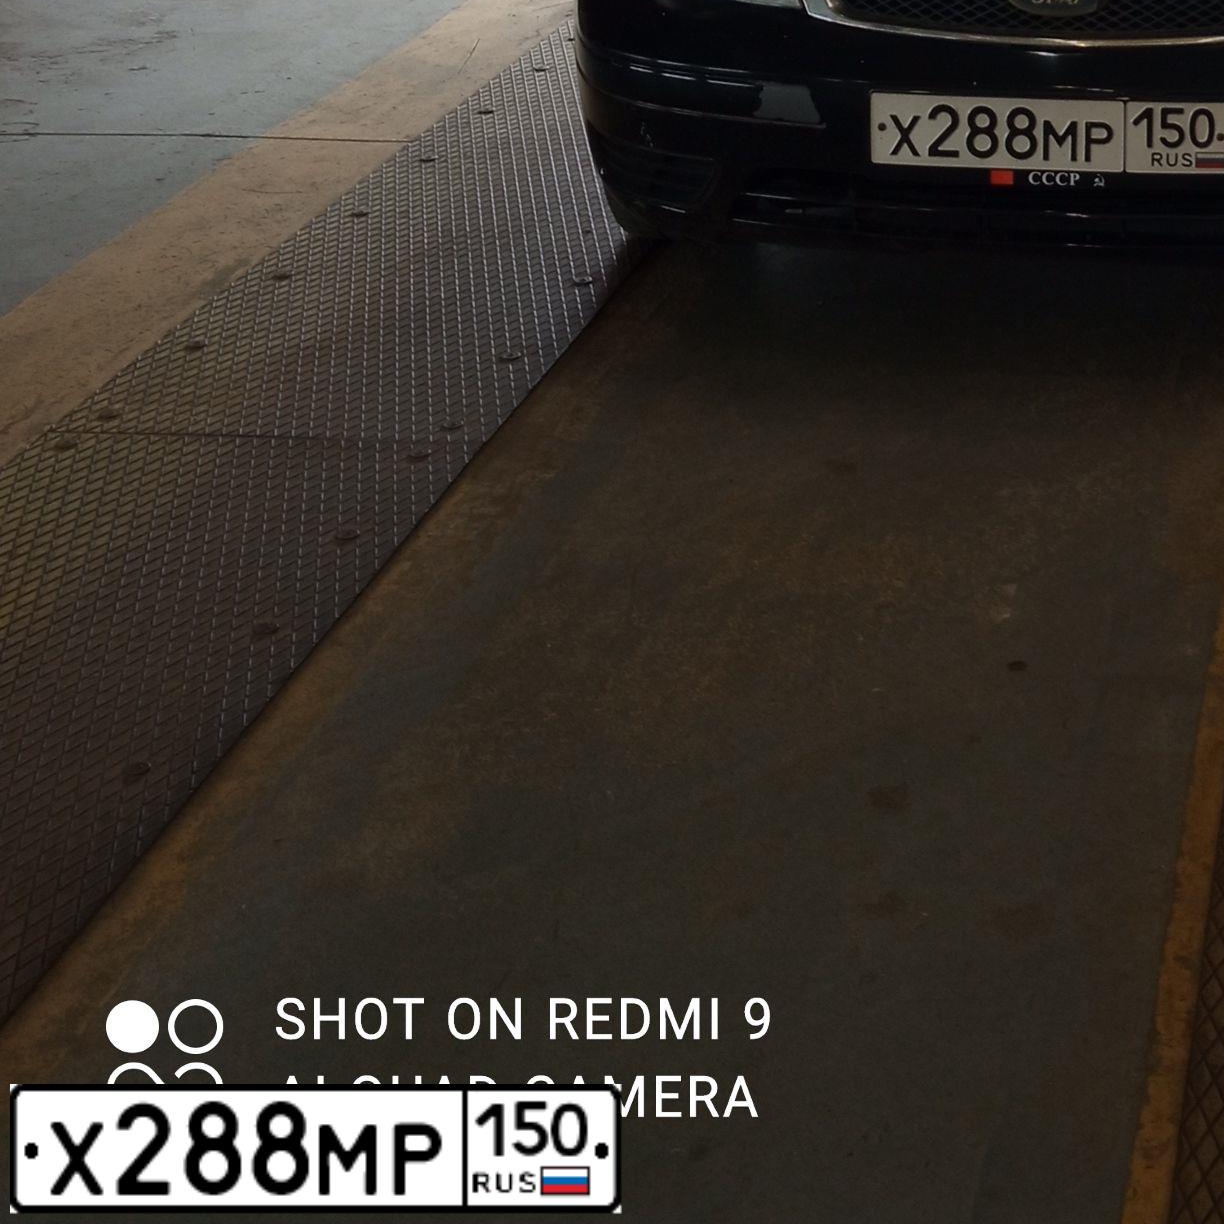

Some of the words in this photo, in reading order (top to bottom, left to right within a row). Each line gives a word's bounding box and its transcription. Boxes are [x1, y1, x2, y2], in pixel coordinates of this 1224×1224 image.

[888, 103, 1114, 163] Х288МР
[1131, 107, 1216, 149] 150
[1150, 152, 1194, 168] RUS
[1027, 171, 1081, 186] СССР
